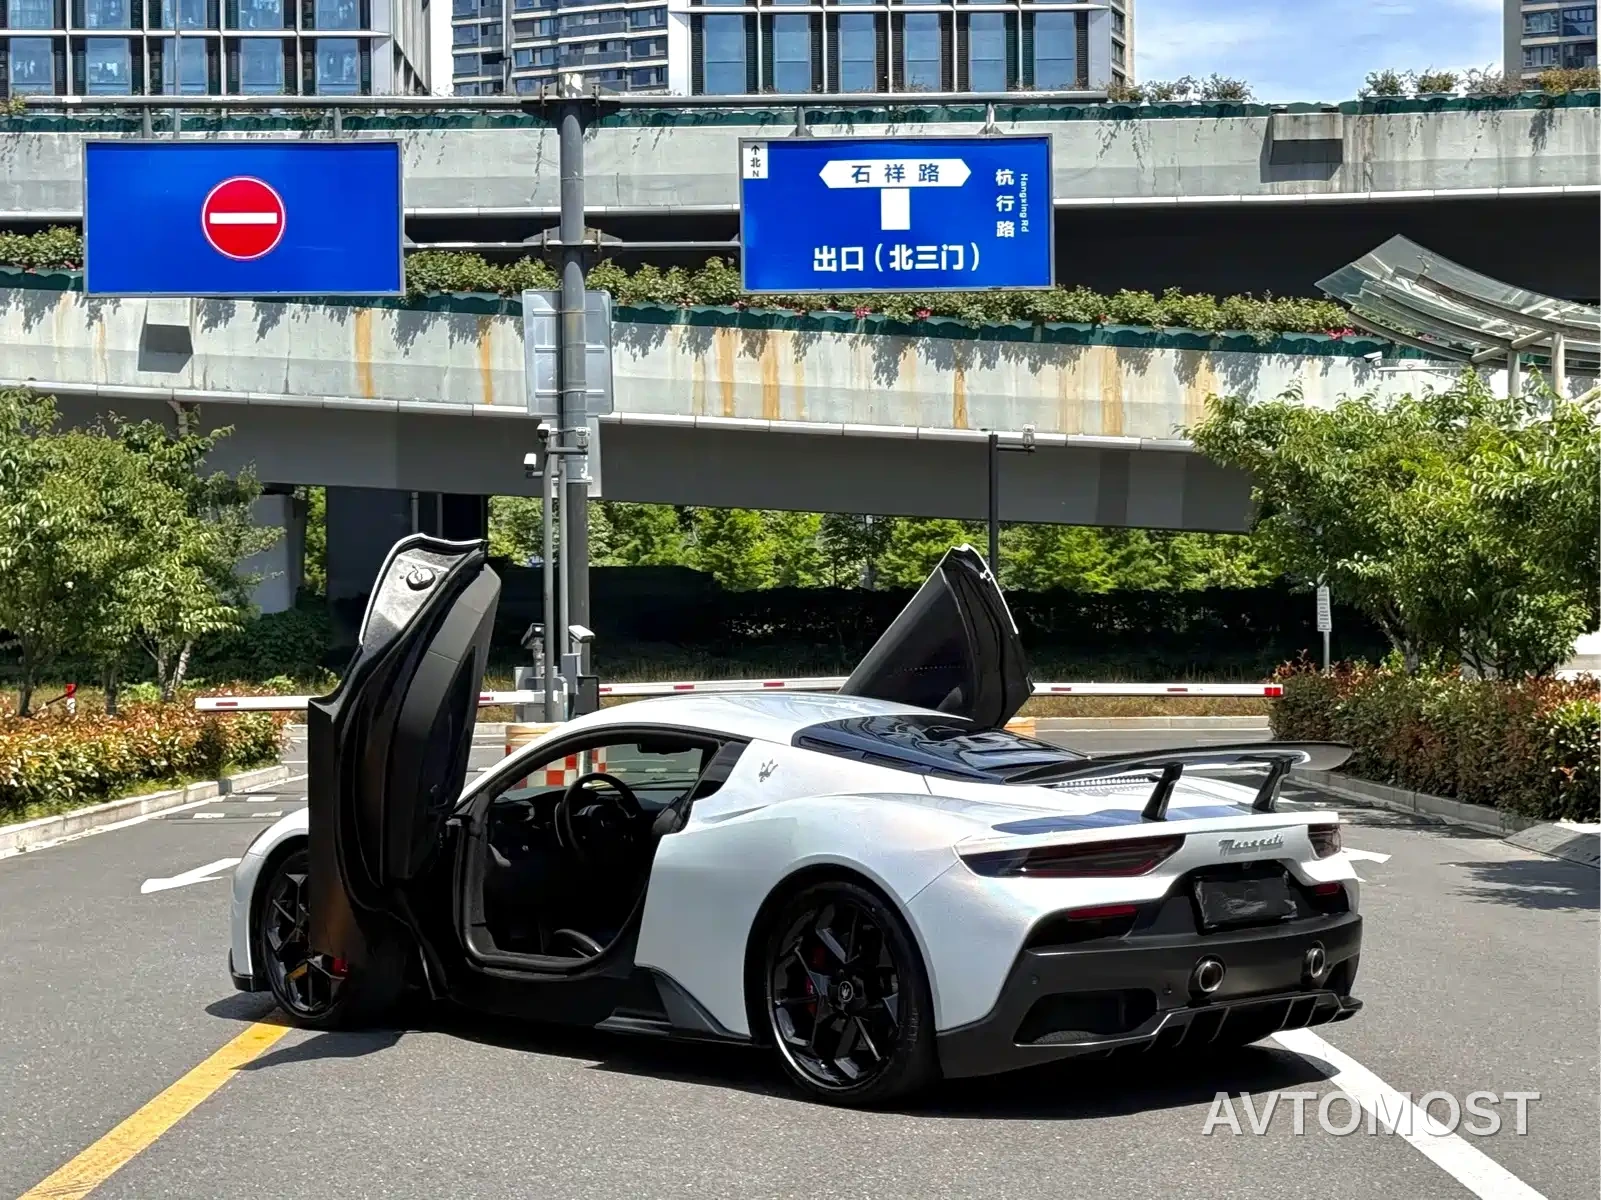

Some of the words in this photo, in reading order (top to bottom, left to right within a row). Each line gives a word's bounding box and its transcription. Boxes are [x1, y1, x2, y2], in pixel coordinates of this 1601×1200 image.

[750, 157, 761, 168] 北
[752, 170, 760, 178] N
[851, 163, 940, 184] 石祥路
[995, 168, 1015, 238] 杭行路
[1019, 173, 1029, 218] Hangxing
[1021, 219, 1029, 233] Rd
